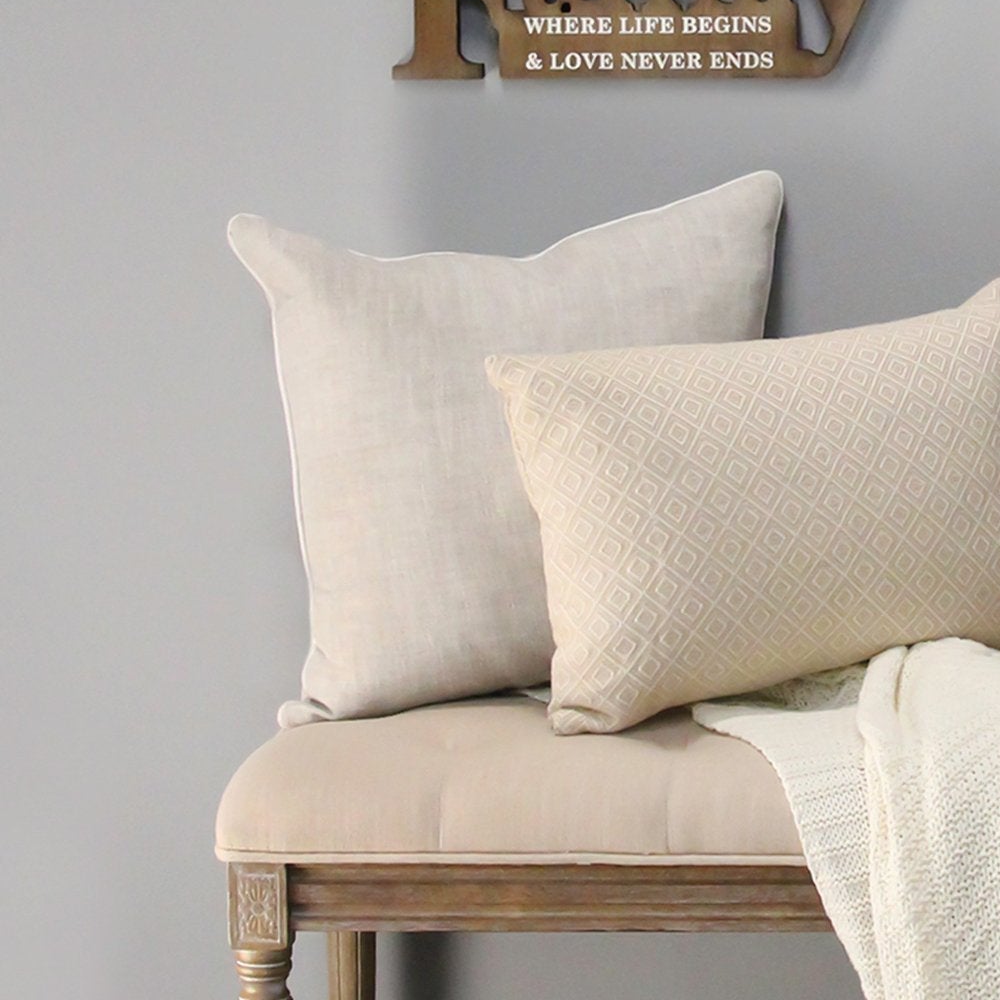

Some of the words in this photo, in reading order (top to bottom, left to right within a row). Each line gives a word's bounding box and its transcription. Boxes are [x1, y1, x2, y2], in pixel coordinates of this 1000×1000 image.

[524, 16, 612, 34] WHERE
[619, 16, 674, 34] LIFE
[682, 16, 772, 34] BEGINS
[525, 53, 543, 70] &
[550, 53, 614, 70] LOVE
[620, 52, 702, 70] NEVER
[709, 52, 774, 69] ENDS
